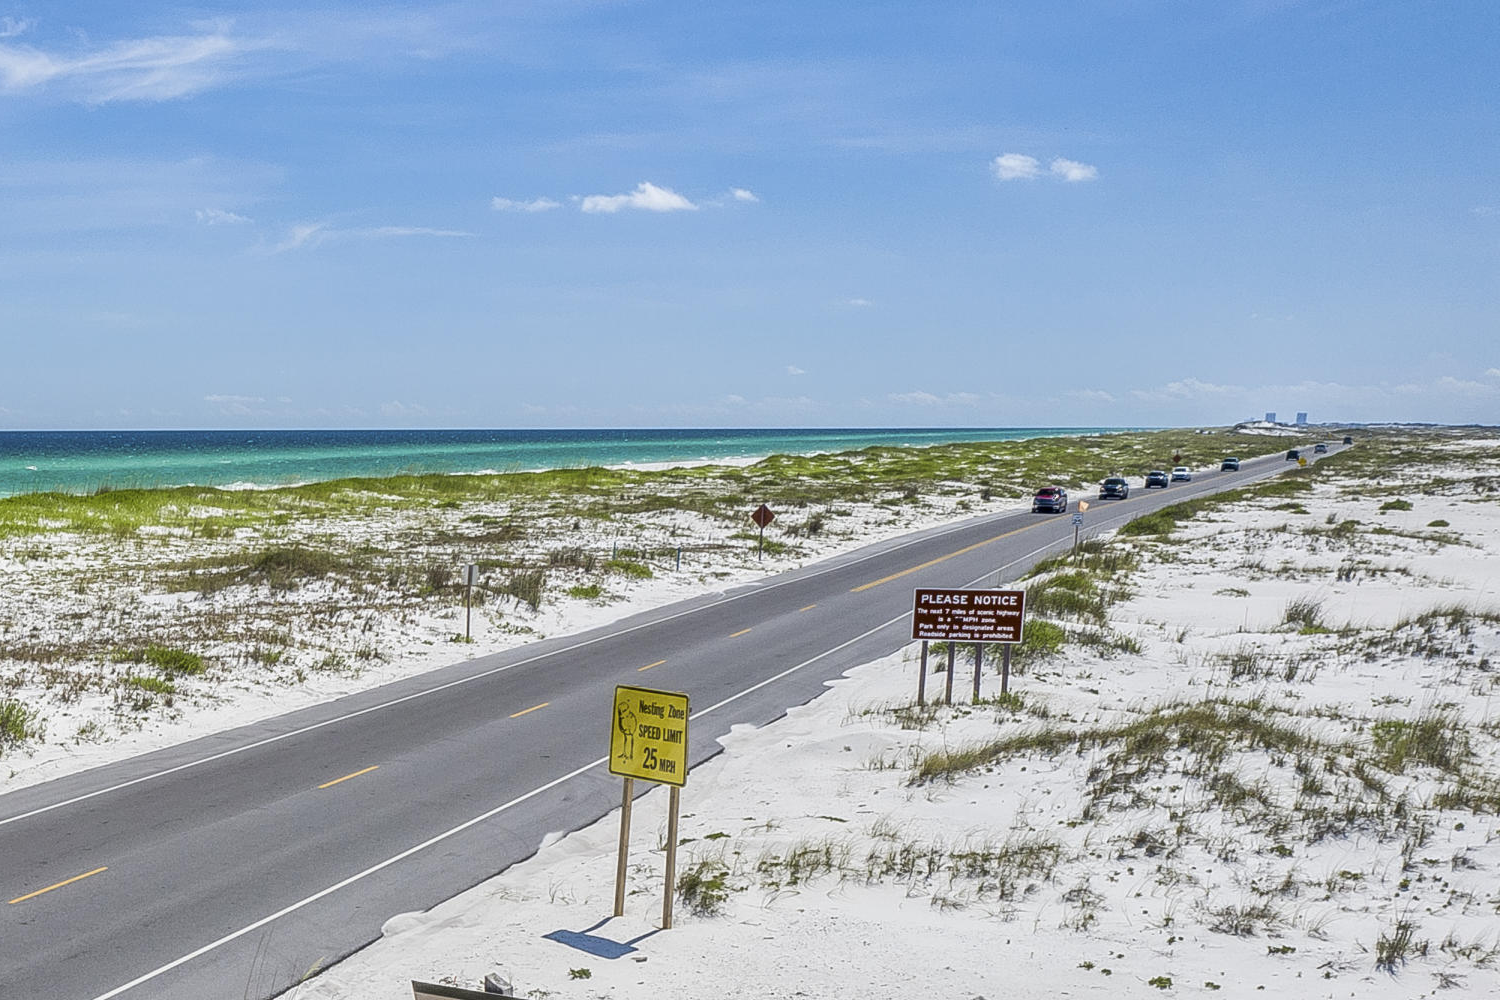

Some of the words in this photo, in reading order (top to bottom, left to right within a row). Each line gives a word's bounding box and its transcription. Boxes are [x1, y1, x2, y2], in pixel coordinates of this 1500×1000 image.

[921, 594, 969, 605] PLEASE
[974, 595, 1018, 606] NOTICE
[996, 609, 1020, 617] highway
[962, 624, 994, 632] designated
[639, 700, 665, 719] Nesting
[668, 704, 685, 720] Zone
[638, 724, 661, 741] SPEED
[663, 727, 683, 744] LIMIT
[642, 747, 658, 770] 25
[659, 758, 676, 774] MPH
